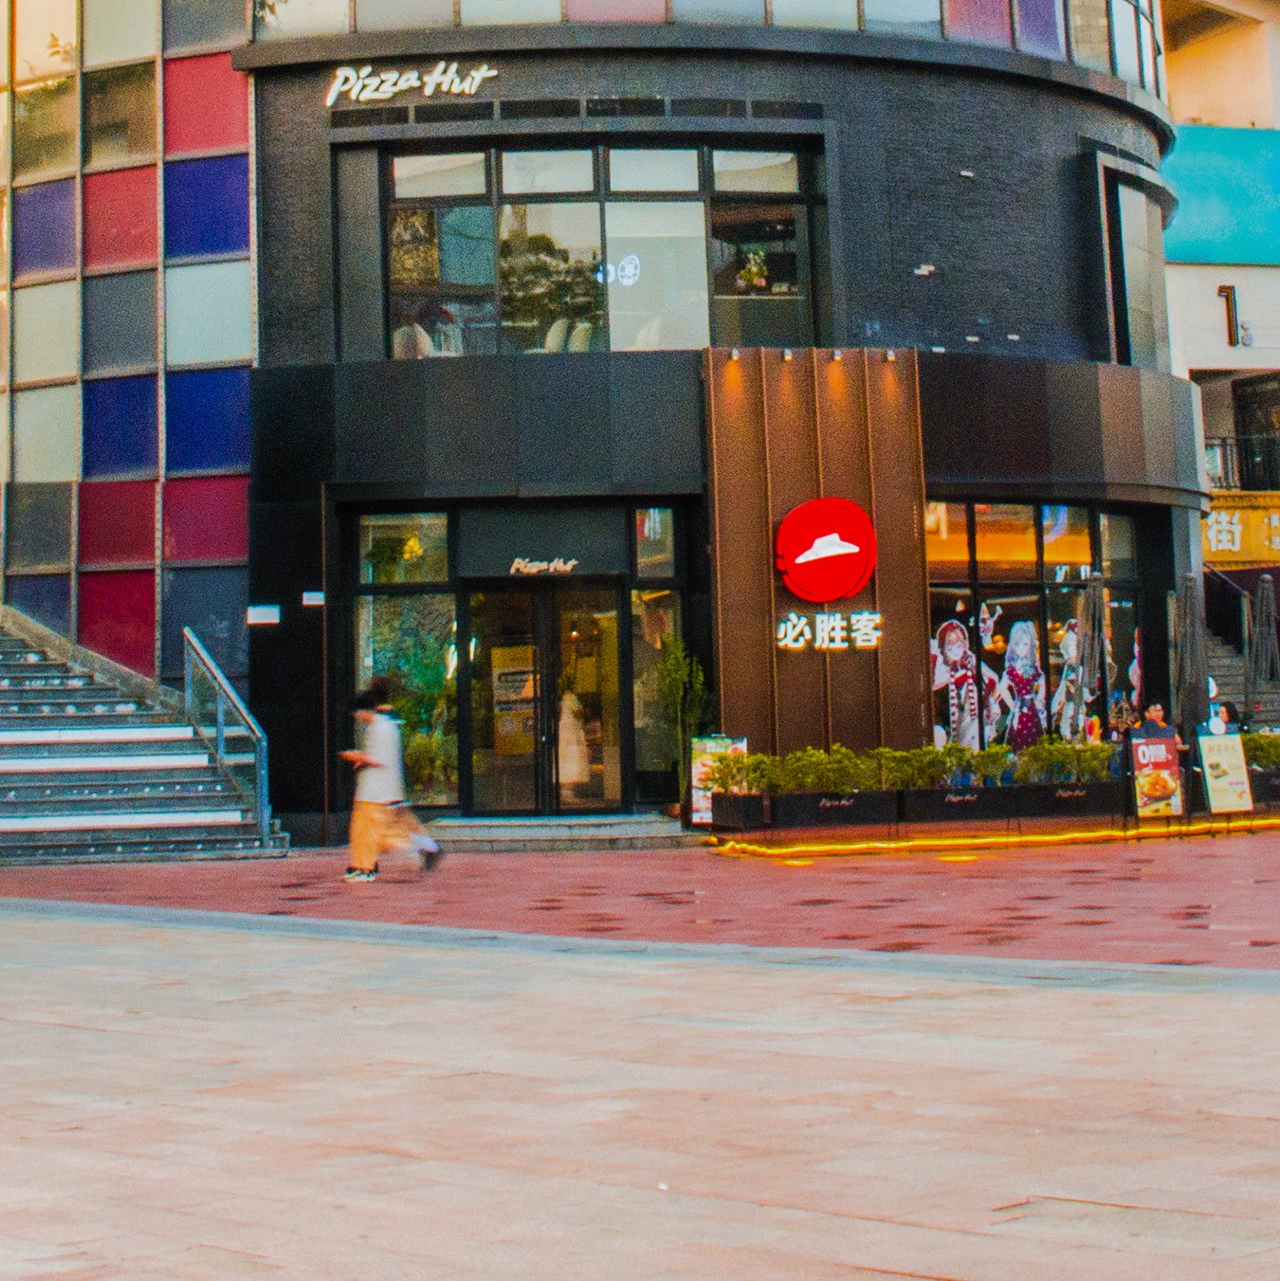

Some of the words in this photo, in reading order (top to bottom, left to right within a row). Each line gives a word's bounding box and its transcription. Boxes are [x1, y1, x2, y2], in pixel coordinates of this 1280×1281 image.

[325, 65, 420, 107] Pizza
[423, 60, 499, 96] Hut
[1207, 511, 1242, 551] 街
[777, 609, 883, 651] 必胜客
